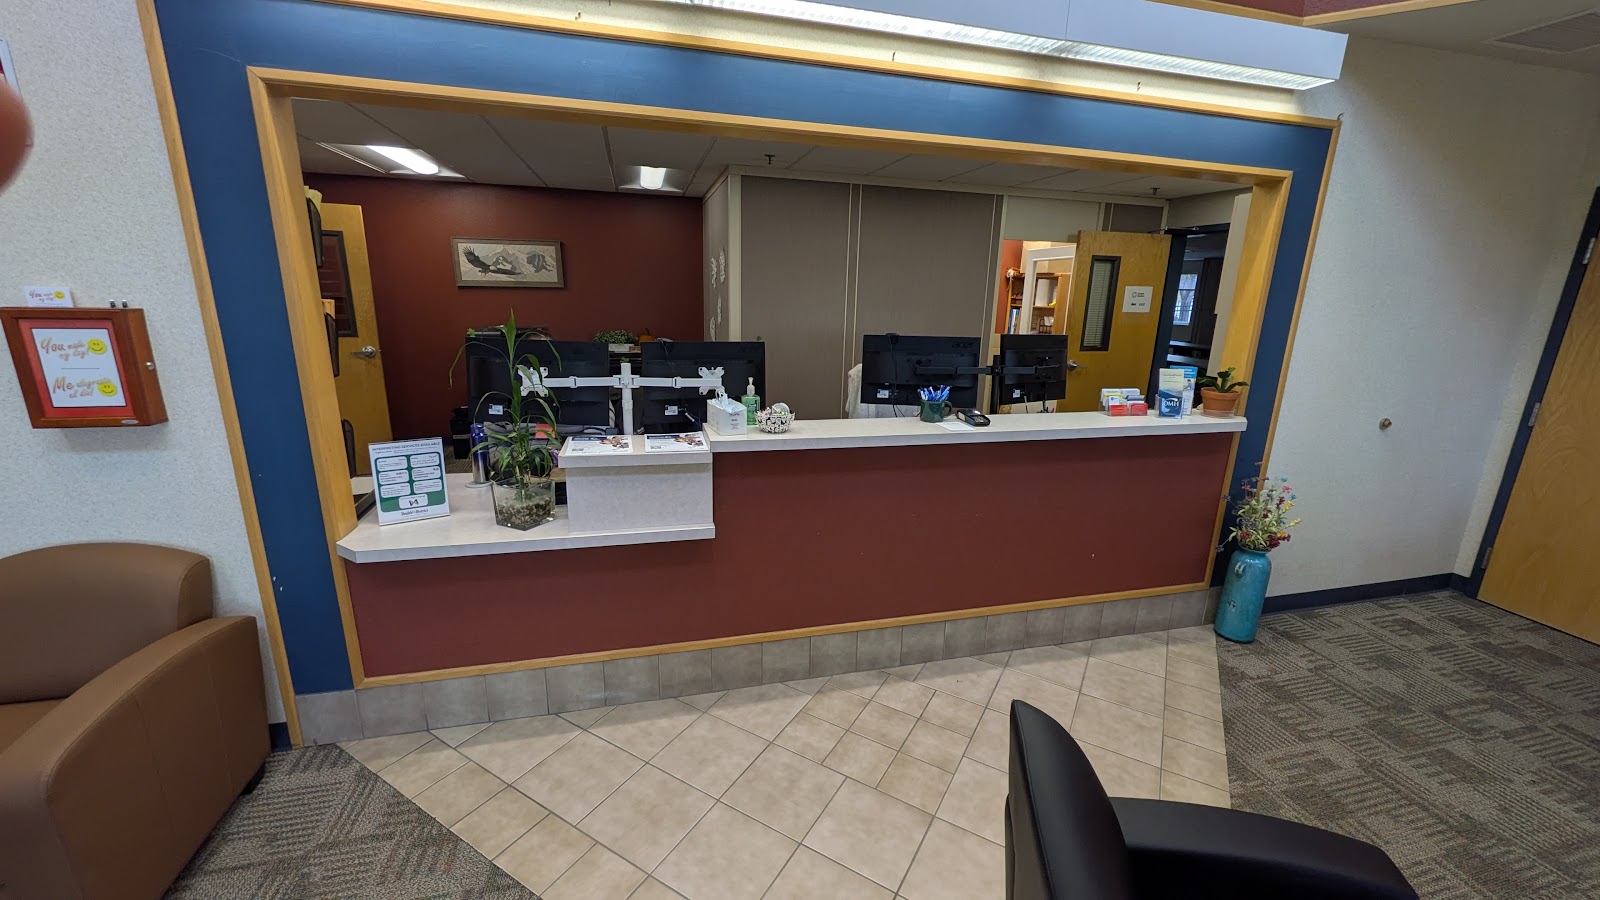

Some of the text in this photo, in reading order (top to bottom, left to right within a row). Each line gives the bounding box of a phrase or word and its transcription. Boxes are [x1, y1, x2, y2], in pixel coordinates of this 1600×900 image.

[29, 290, 42, 299] You
[41, 337, 66, 354] You
[53, 375, 74, 394] Me
